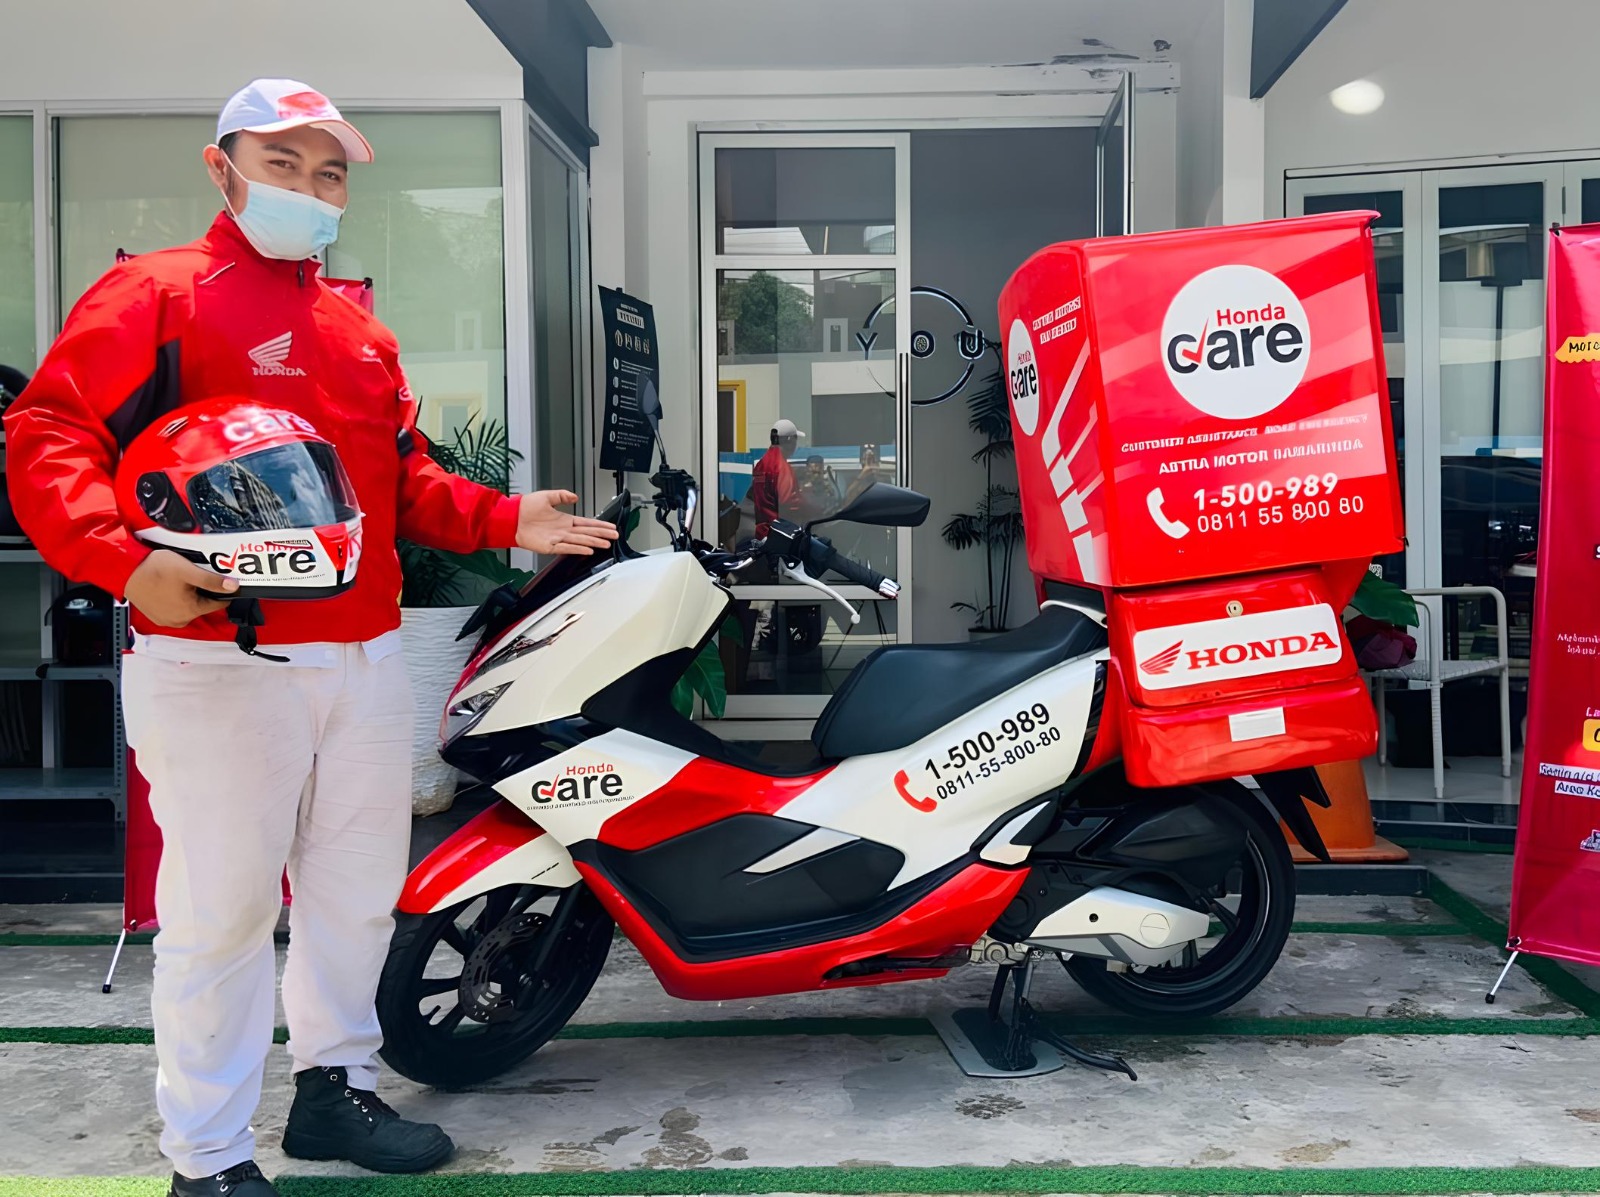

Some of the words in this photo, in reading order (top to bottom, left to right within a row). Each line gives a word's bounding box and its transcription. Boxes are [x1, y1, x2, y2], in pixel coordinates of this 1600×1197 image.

[1216, 303, 1286, 327] Honda
[1167, 322, 1303, 374] care
[251, 366, 307, 377] HONDA
[1010, 363, 1037, 400] care
[1193, 472, 1338, 511] 1-500-989
[1197, 510, 1247, 533] 0811
[1258, 505, 1283, 526] 55
[1292, 500, 1331, 524] 800
[1339, 495, 1364, 515] 80
[210, 546, 317, 575] care
[1186, 631, 1338, 670] HONDA
[925, 703, 1050, 780] 1-500-989
[566, 763, 614, 776] Honda
[936, 726, 1061, 800] 0811-55-800-80
[531, 772, 623, 804] care
